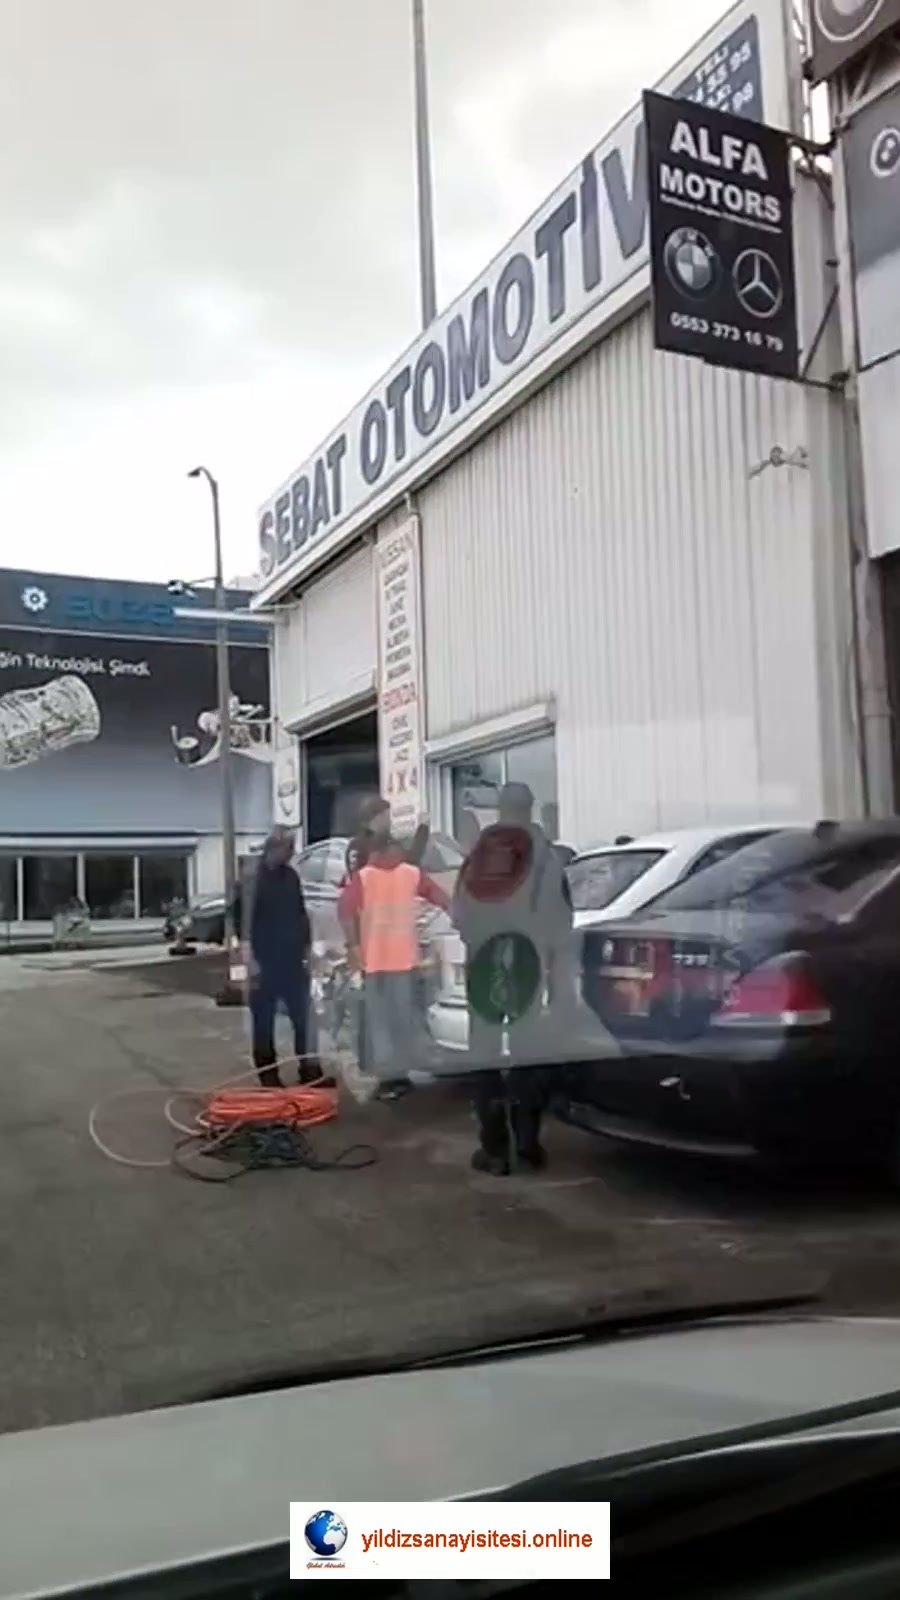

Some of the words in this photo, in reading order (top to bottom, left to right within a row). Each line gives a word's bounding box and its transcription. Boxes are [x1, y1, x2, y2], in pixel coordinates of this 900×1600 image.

[670, 119, 769, 181] ALFA
[660, 163, 781, 223] MOTORS
[670, 311, 709, 334] 0553
[711, 321, 741, 342] 373
[259, 432, 347, 578] SEBAT
